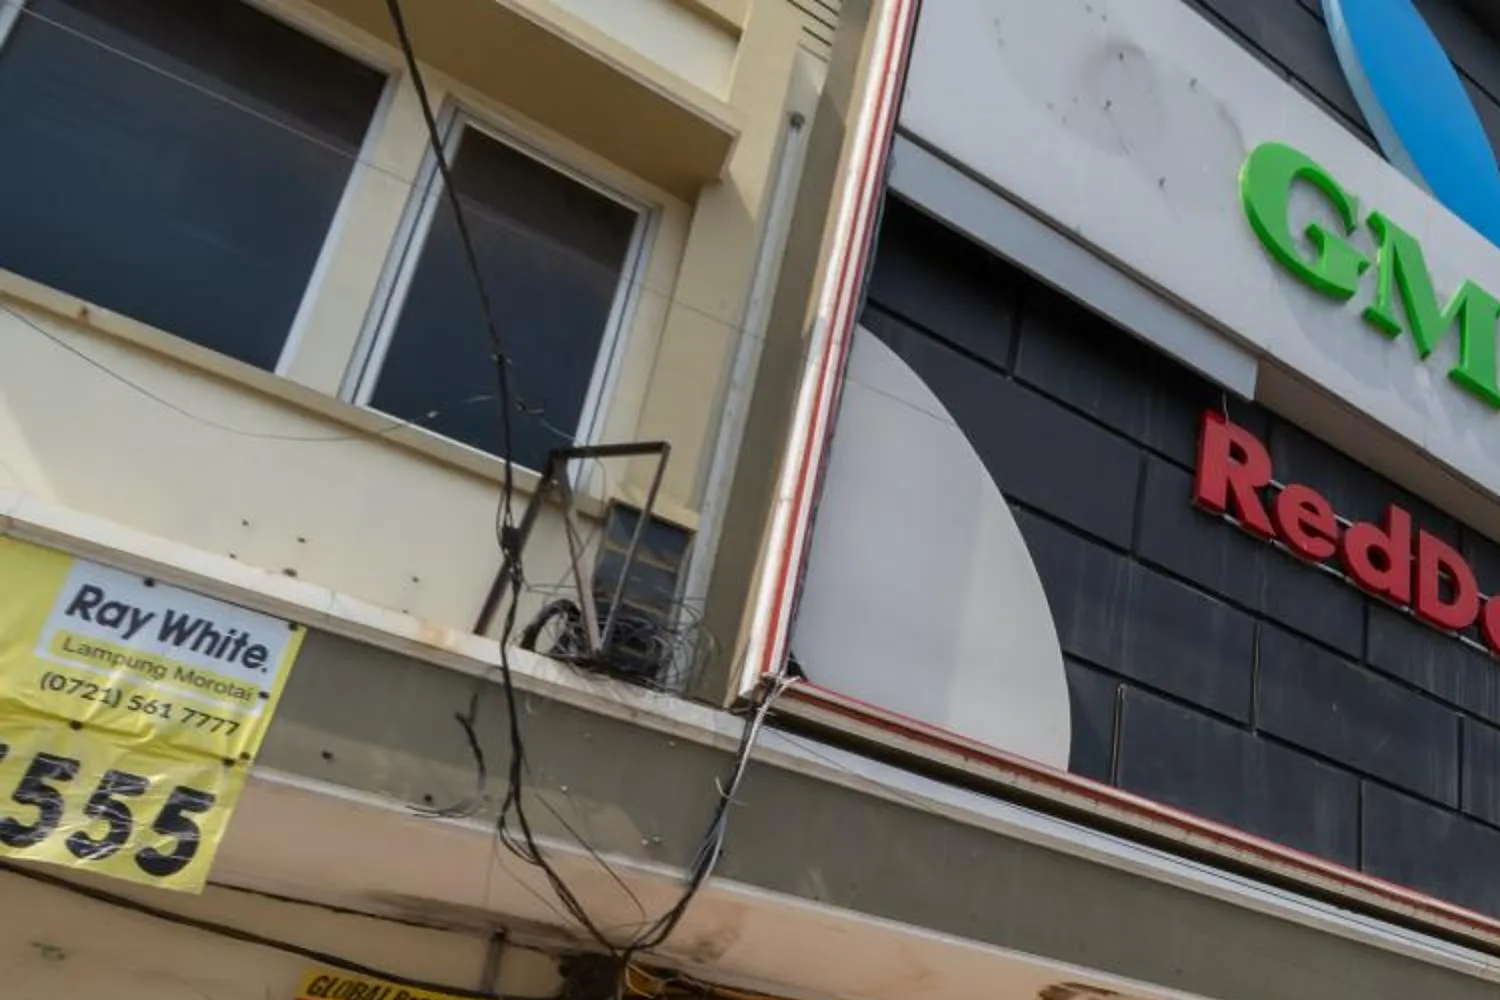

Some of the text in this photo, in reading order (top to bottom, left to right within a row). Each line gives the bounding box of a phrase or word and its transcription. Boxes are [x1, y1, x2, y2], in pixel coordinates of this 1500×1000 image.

[65, 583, 155, 640] Ray
[62, 636, 255, 702] Lampung Morotai
[40, 671, 240, 737] (0721) 561 7777
[0, 742, 216, 877] 555
